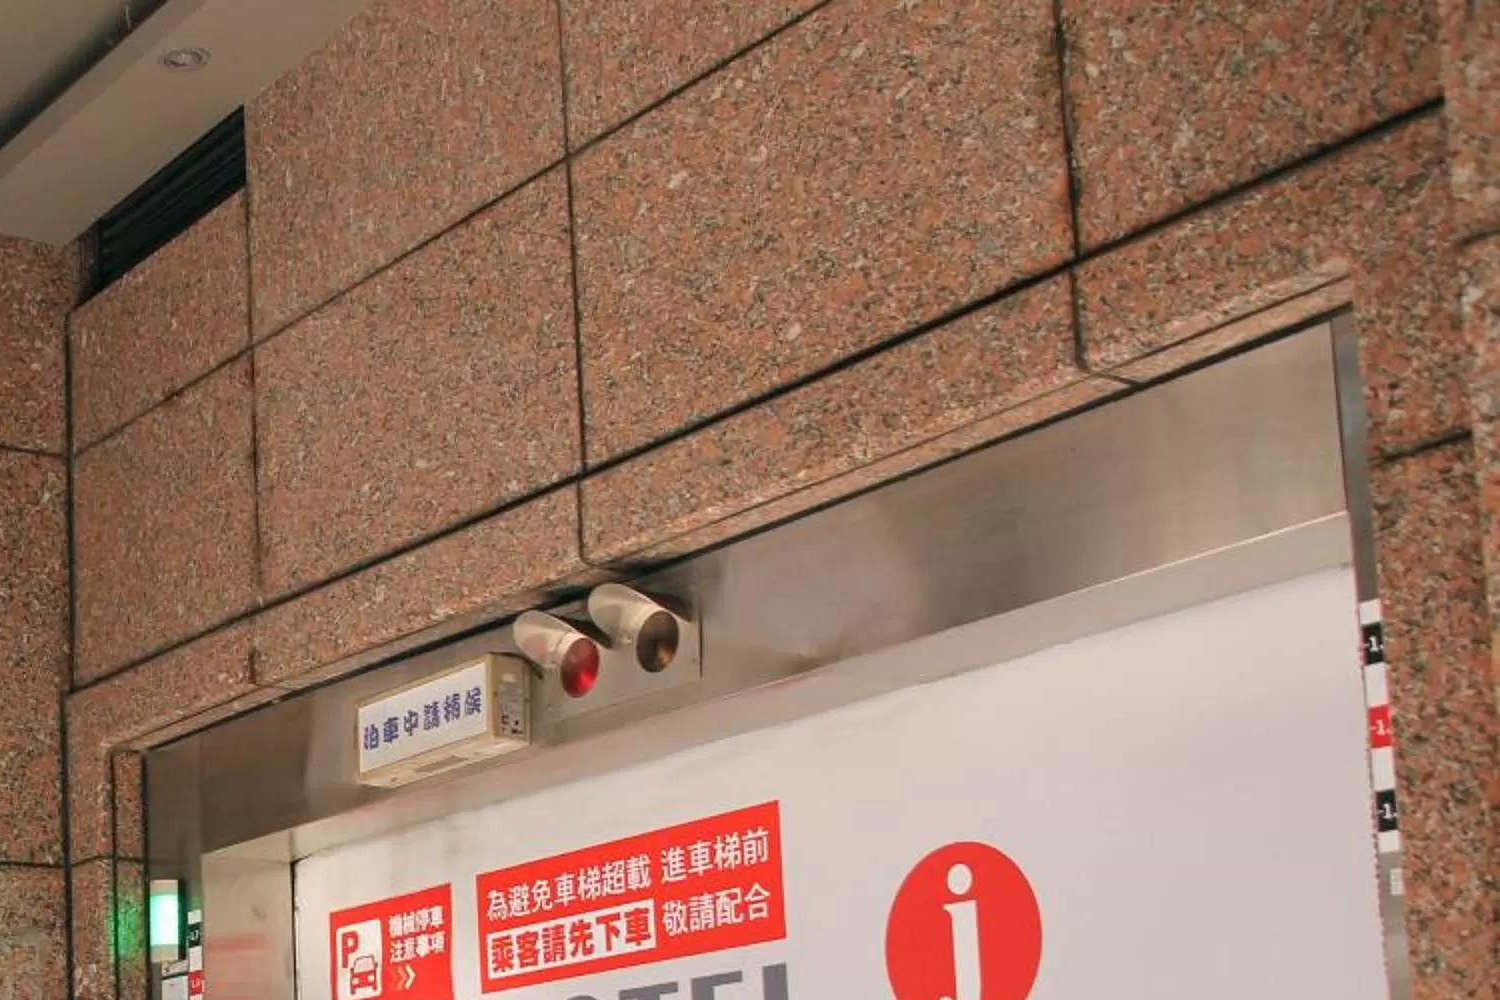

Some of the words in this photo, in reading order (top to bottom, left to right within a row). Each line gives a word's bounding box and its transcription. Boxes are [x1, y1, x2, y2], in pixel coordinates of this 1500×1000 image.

[486, 854, 652, 921] 為避免車梯超載
[660, 827, 770, 883] 進車梯前
[341, 931, 359, 969] P
[491, 907, 652, 973] 乘客請先下車
[662, 882, 771, 937] 敬請配合
